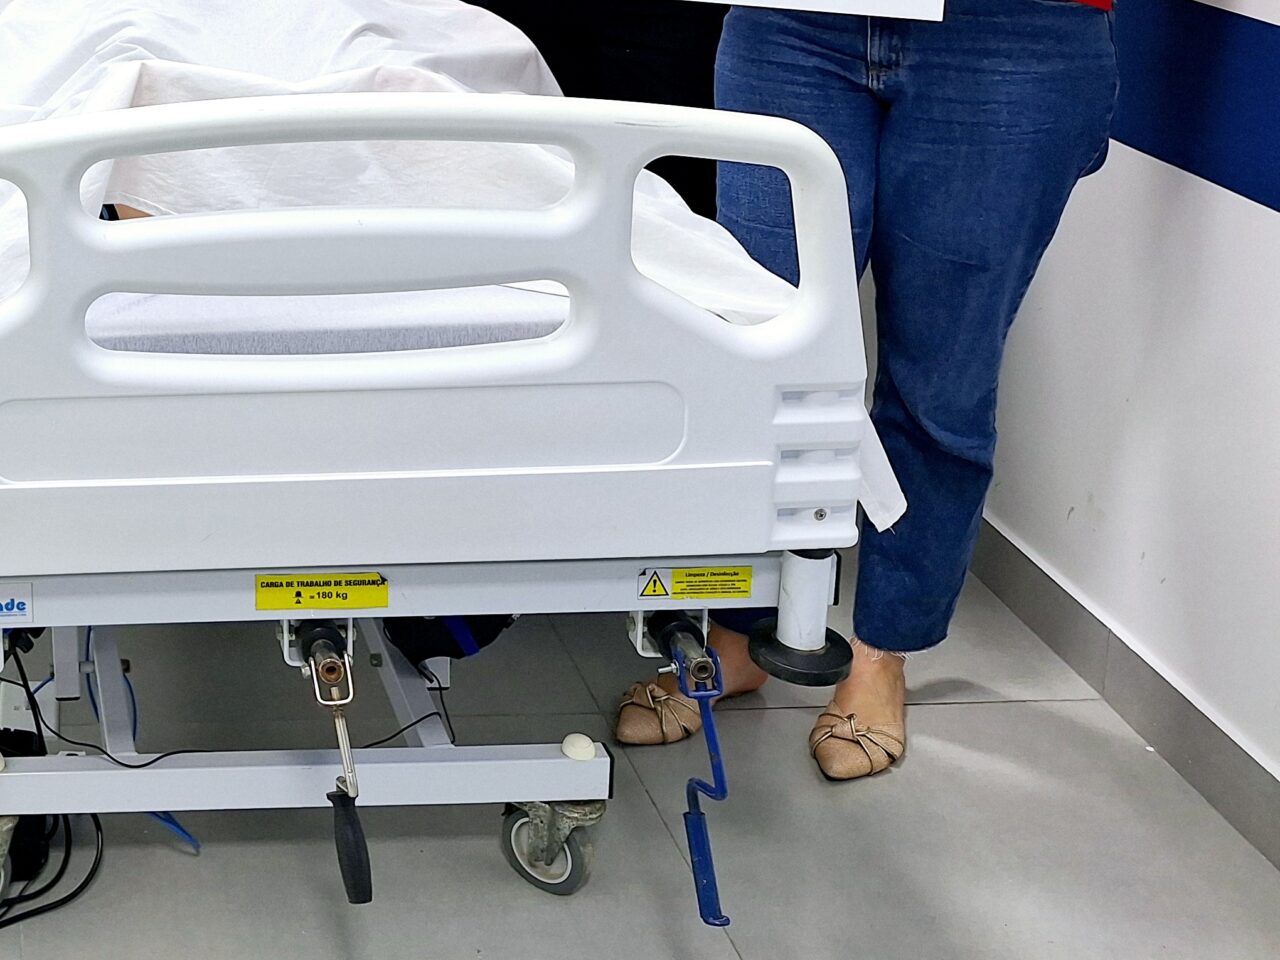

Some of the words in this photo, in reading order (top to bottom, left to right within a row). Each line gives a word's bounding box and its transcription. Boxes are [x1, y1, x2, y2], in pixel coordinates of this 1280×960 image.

[296, 580, 332, 588] TRABALHO
[344, 579, 386, 588] SEGURANÇA
[316, 591, 333, 599] 180
[335, 591, 348, 600] kg
